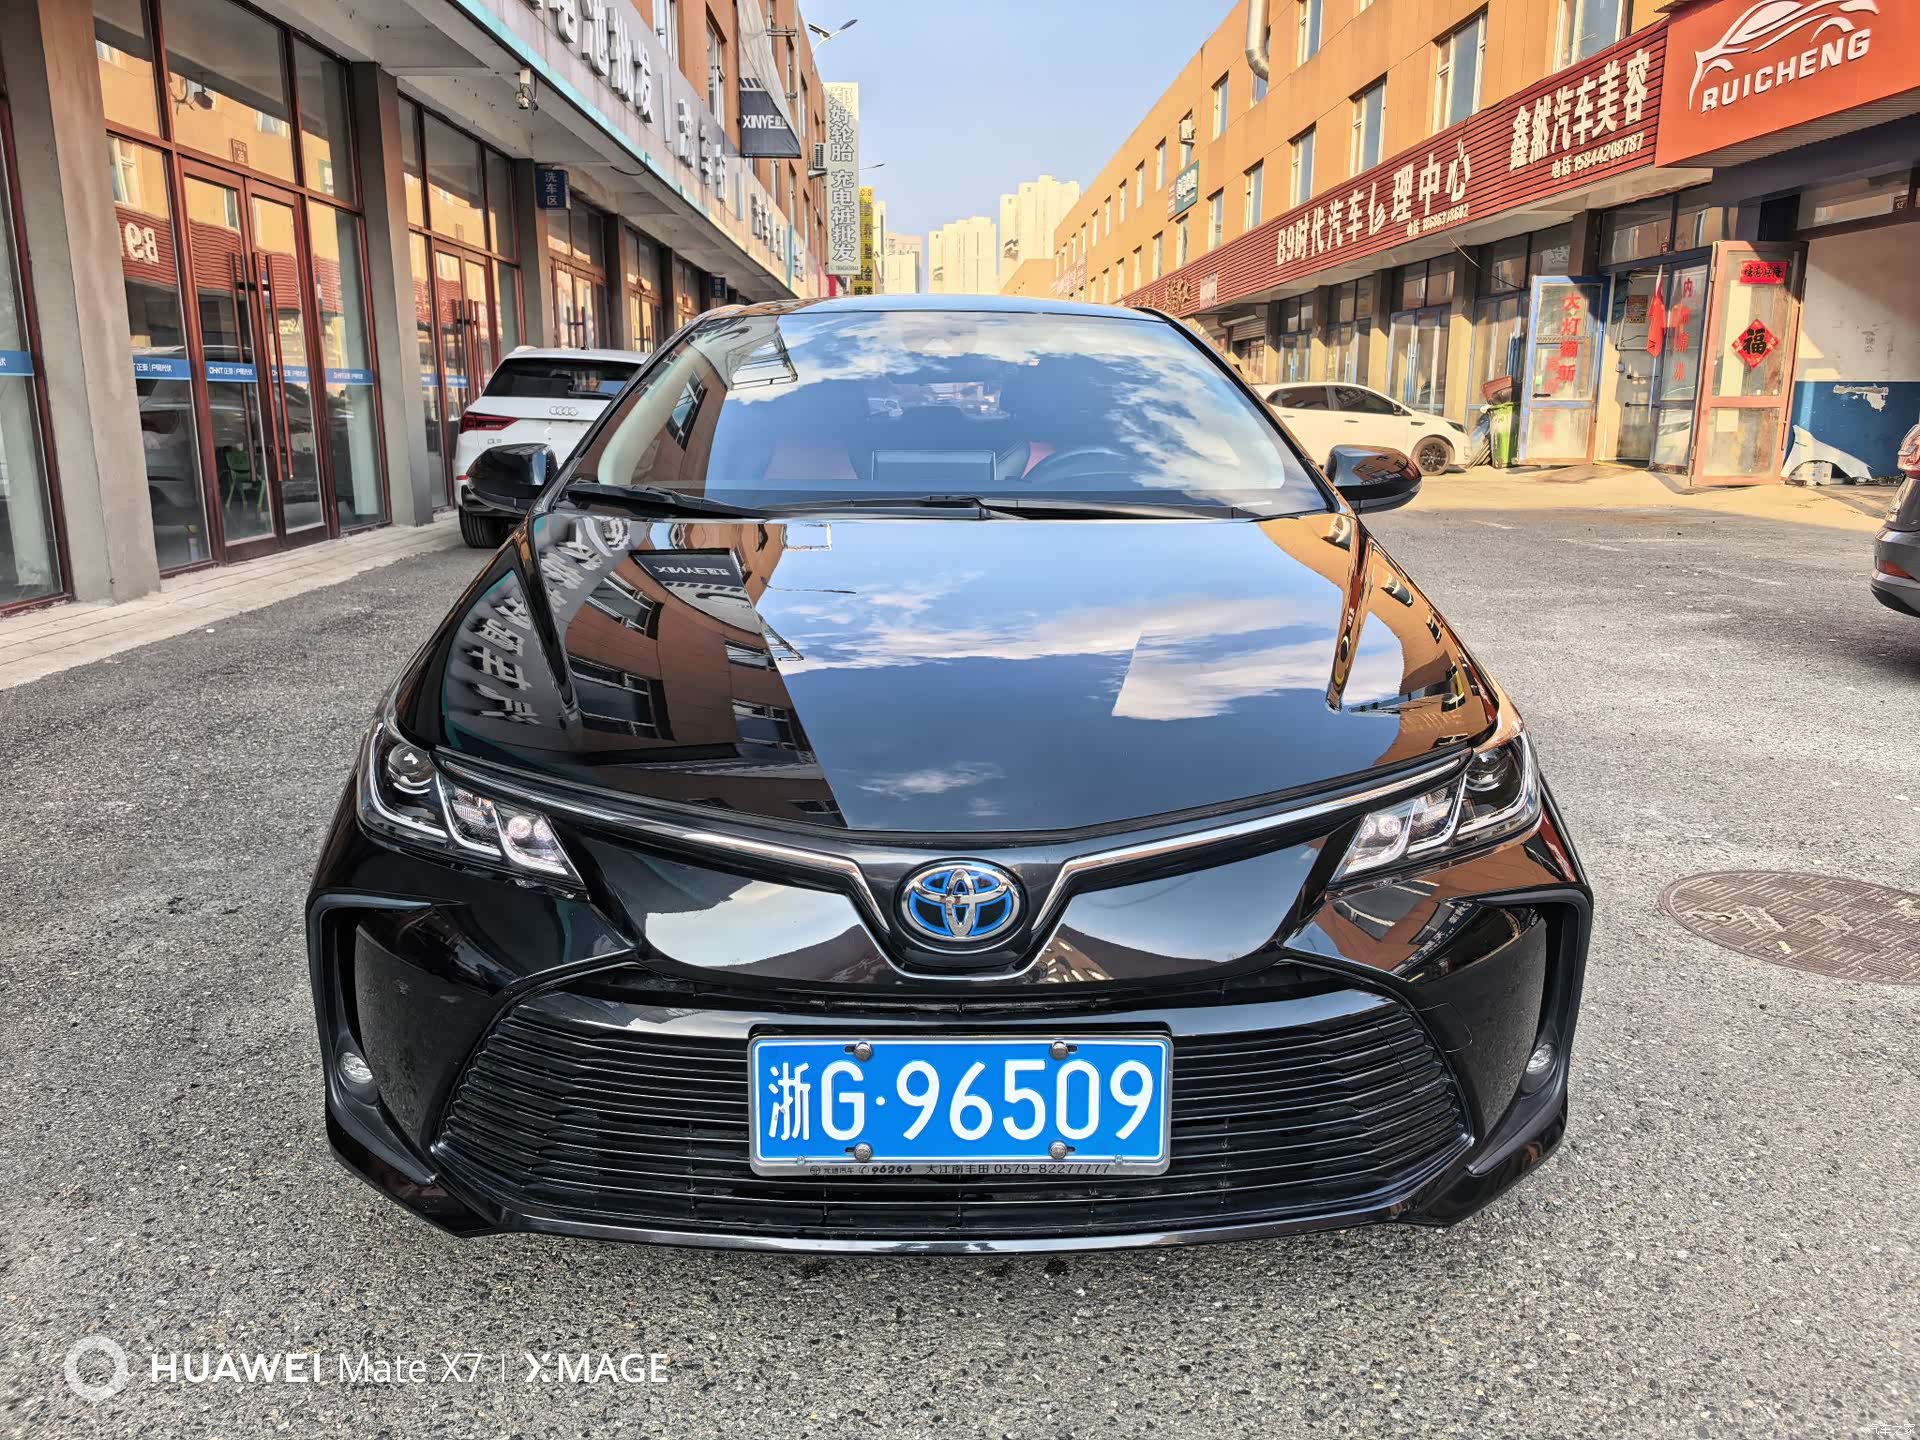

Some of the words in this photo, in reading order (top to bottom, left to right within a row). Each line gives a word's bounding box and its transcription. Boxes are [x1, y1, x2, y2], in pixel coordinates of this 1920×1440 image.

[1701, 28, 1872, 113] RUICHENG
[742, 115, 774, 129] XINYE
[1574, 131, 1645, 172] 15844208787
[545, 171, 558, 206] 洗车区
[831, 169, 856, 262] 充电桩批发
[1742, 328, 1768, 355] 福
[871, 1164, 913, 1174] 96296
[925, 1164, 989, 1174] 大江南丰田
[994, 1163, 1110, 1174] 0579-82277777
